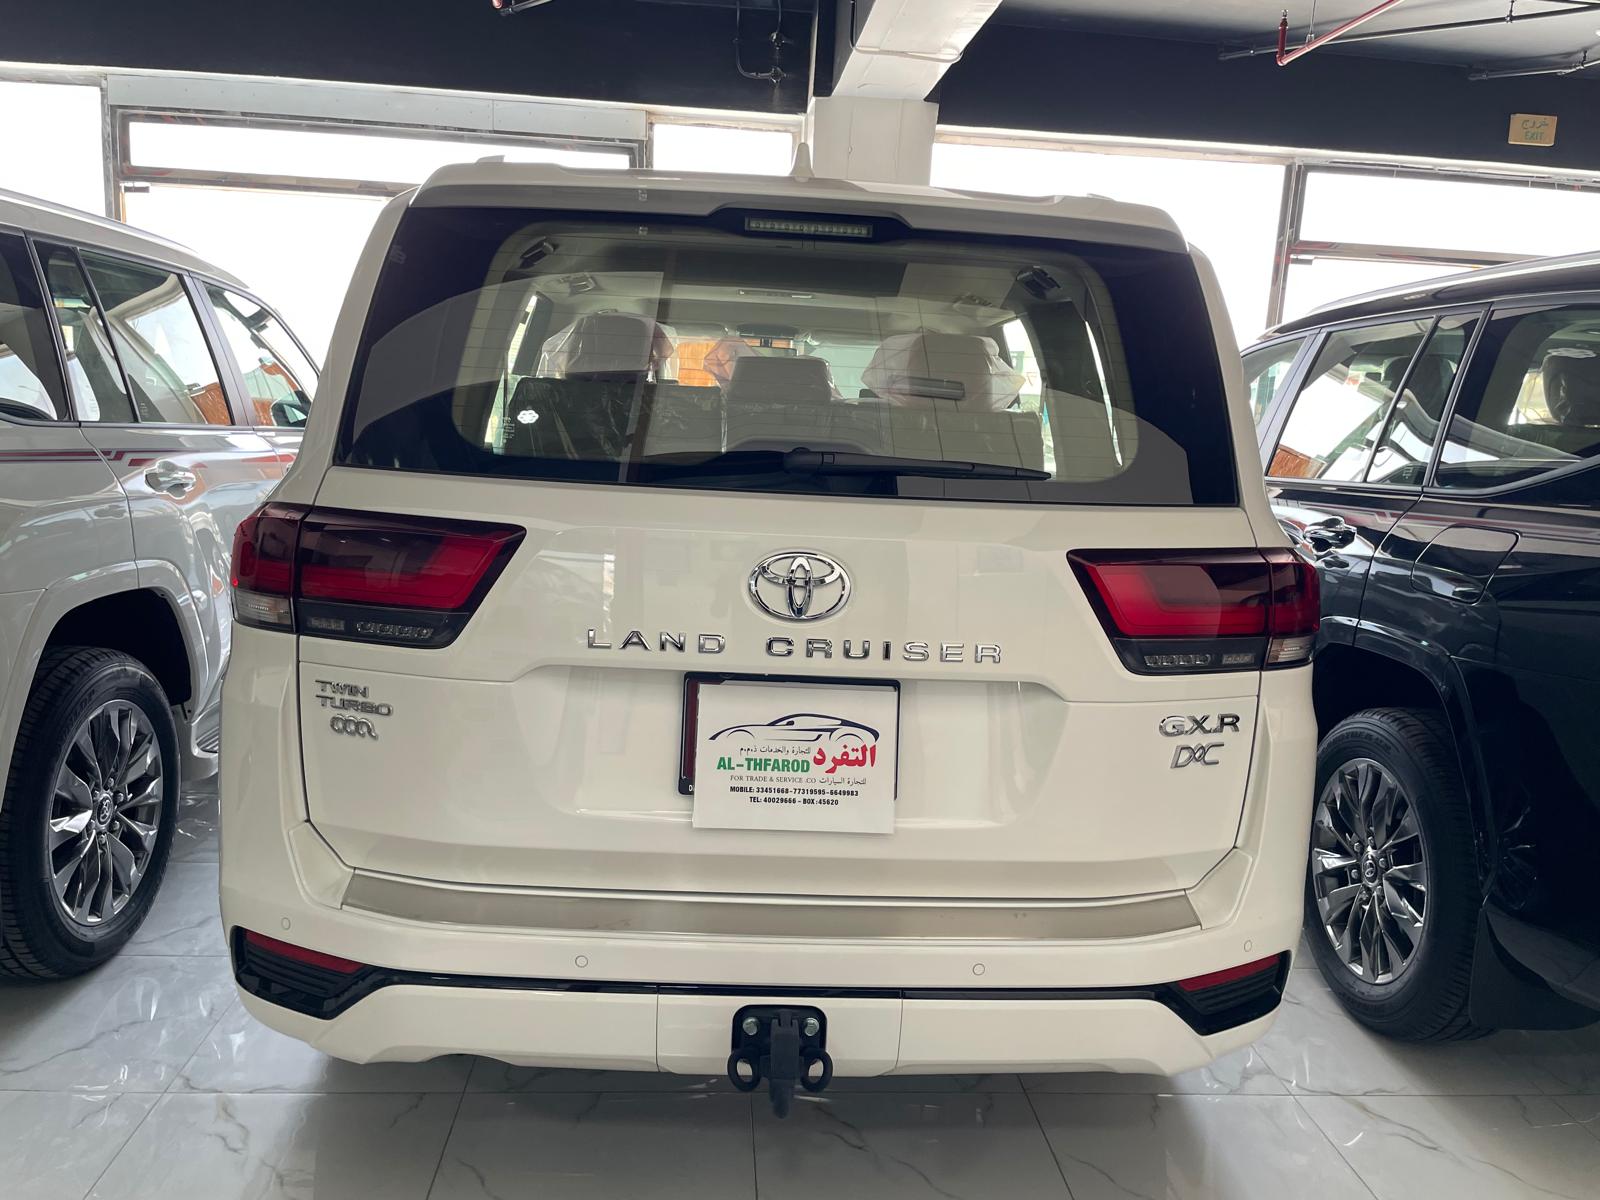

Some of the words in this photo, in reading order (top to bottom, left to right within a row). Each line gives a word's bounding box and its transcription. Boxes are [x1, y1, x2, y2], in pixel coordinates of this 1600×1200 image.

[1524, 131, 1545, 141] EXIT
[588, 628, 726, 654] LAND
[766, 636, 1002, 664] CRUISER
[315, 679, 369, 698] TWIN
[315, 695, 393, 716] TURBO
[1159, 713, 1240, 737] GXR
[716, 756, 811, 773] AL-THFAROD
[813, 743, 877, 774] التفرد
[730, 774, 744, 782] FOR
[746, 775, 767, 783] TRADE
[776, 776, 802, 784] SERVICE
